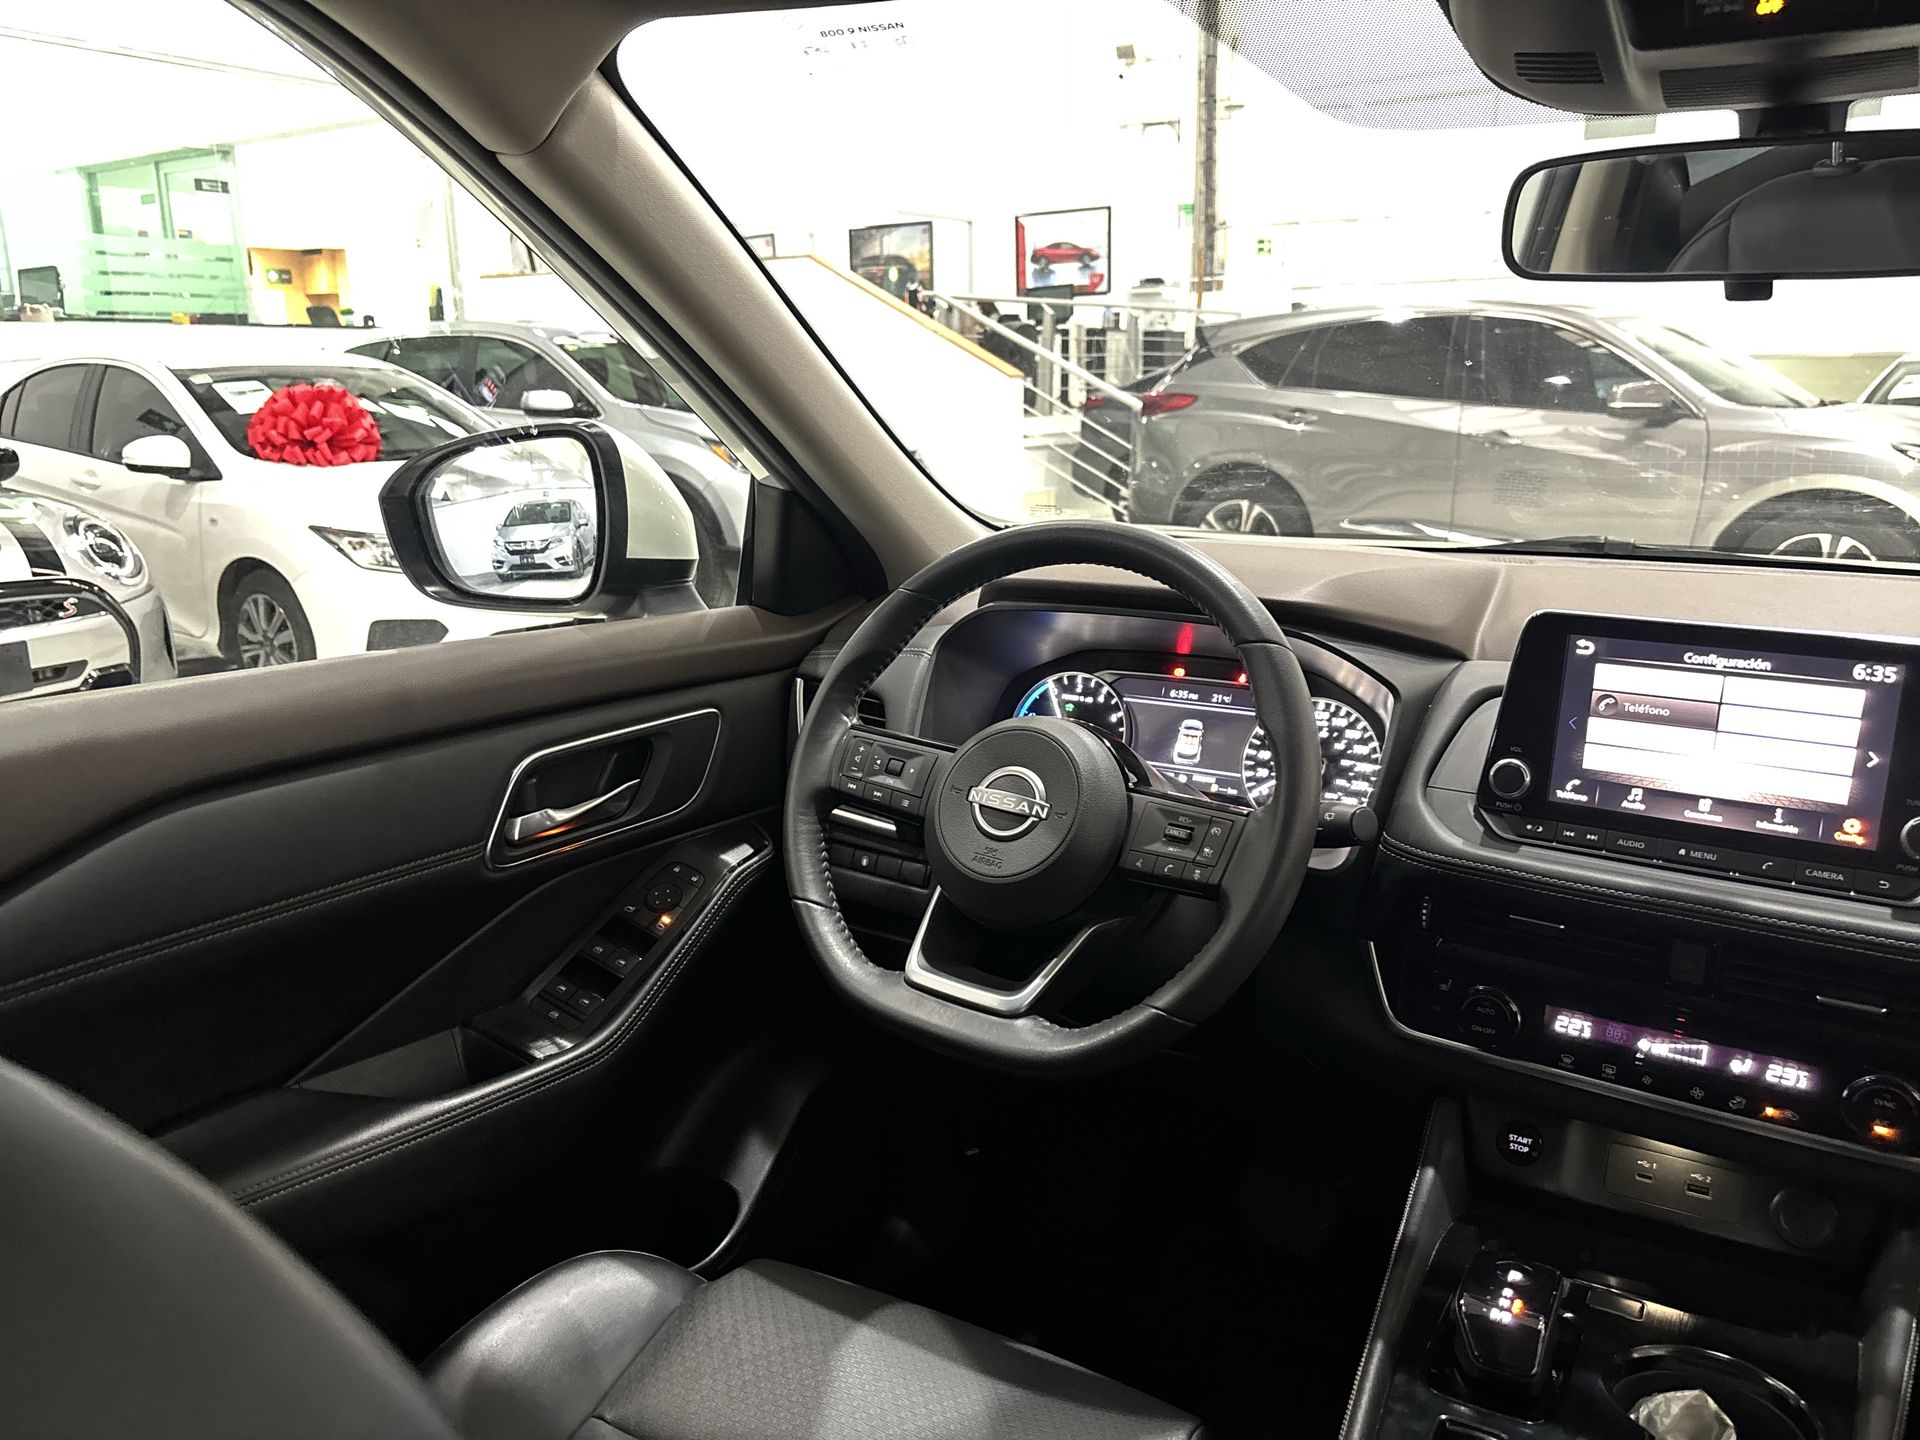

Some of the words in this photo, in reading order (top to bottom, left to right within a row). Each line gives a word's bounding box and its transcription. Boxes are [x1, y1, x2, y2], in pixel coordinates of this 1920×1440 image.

[819, 29, 845, 38] 800
[857, 22, 904, 33] NISSAN
[1683, 651, 1772, 671] Configuración
[1852, 663, 1898, 684] 6:35
[1623, 701, 1671, 717] Teléfono
[968, 789, 1049, 819] NISSAN
[1495, 800, 1513, 810] PUSH
[1165, 828, 1187, 840] CANCEL
[1616, 838, 1646, 850] AUDIO
[971, 854, 1003, 870] AIRBAG
[1689, 850, 1718, 861] MENU
[1805, 868, 1845, 882] CAMERA
[1476, 1006, 1496, 1016] AUTO
[1508, 1133, 1533, 1146] START
[1509, 1142, 1530, 1154] STOP
[1705, 1175, 1712, 1184] 2
